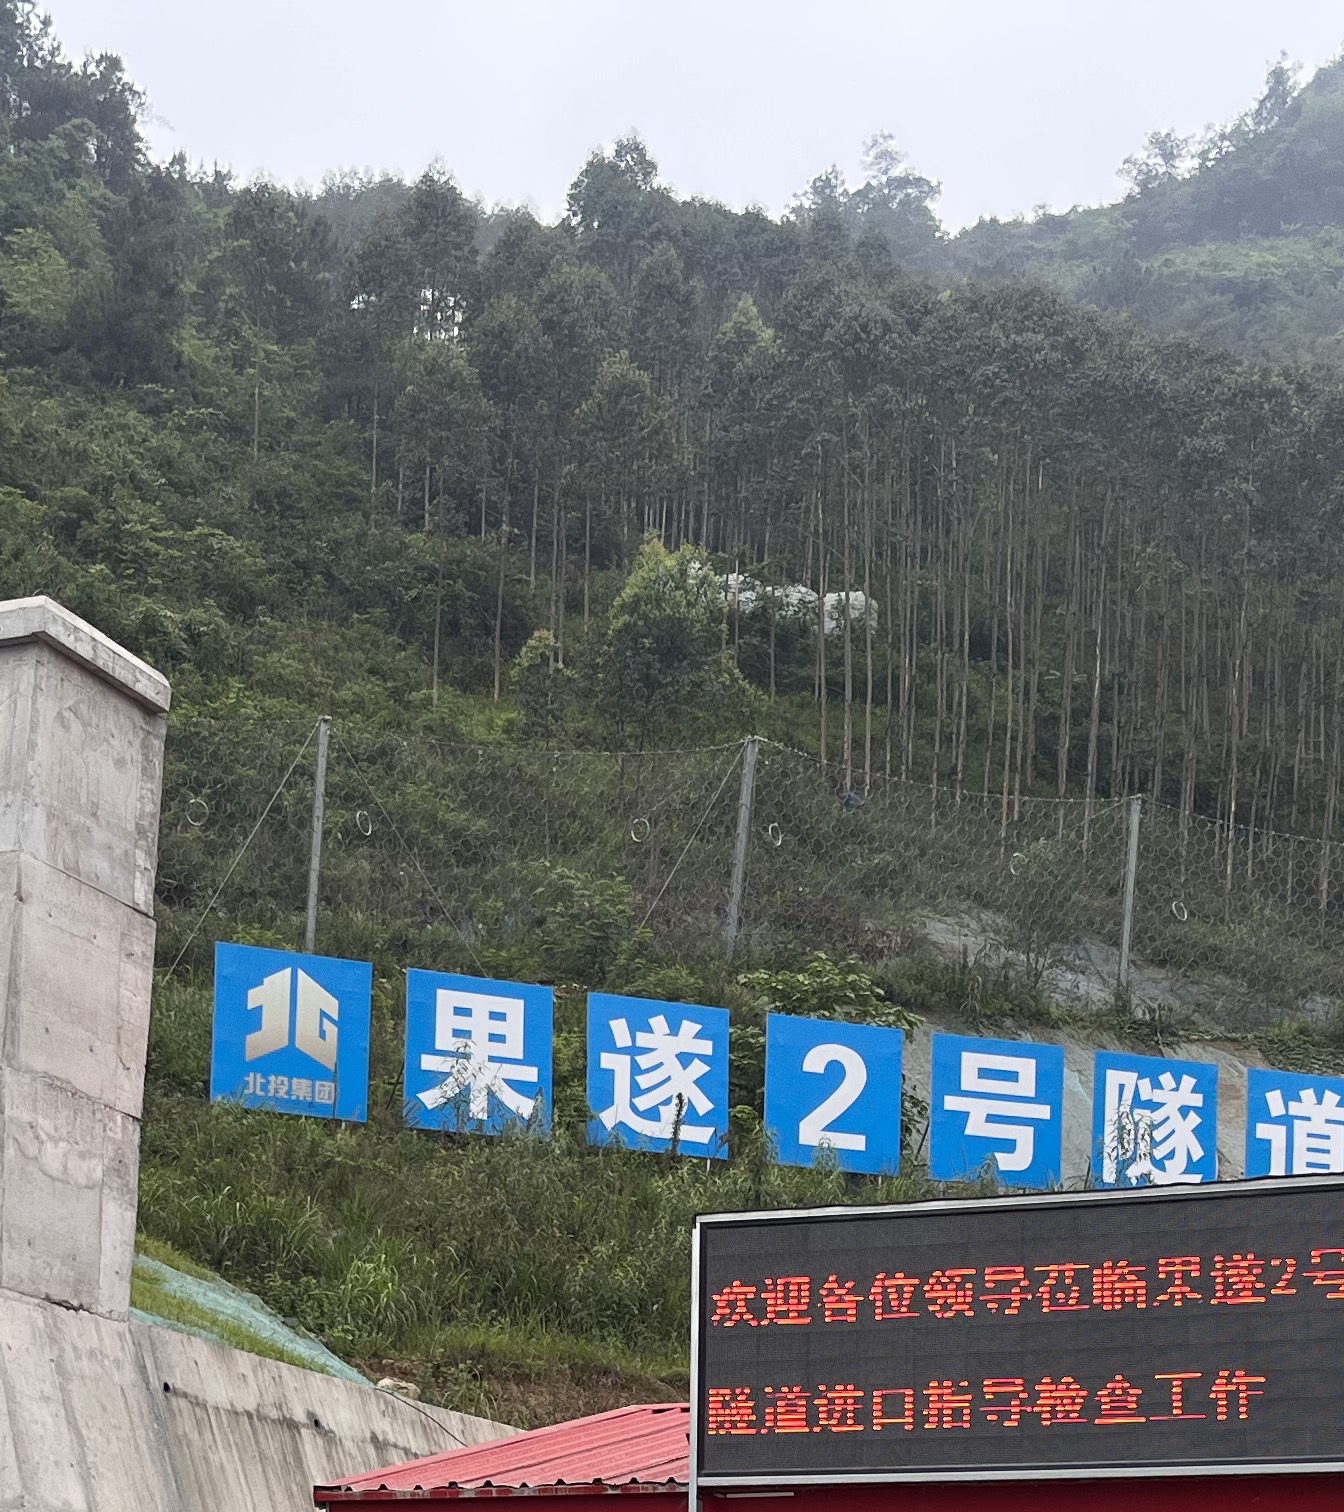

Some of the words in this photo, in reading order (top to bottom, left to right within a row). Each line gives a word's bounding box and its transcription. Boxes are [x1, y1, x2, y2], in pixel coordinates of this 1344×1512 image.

[243, 1071, 336, 1105] 北投集团
[707, 1369, 1267, 1435] 隧道进口指导检查工作
